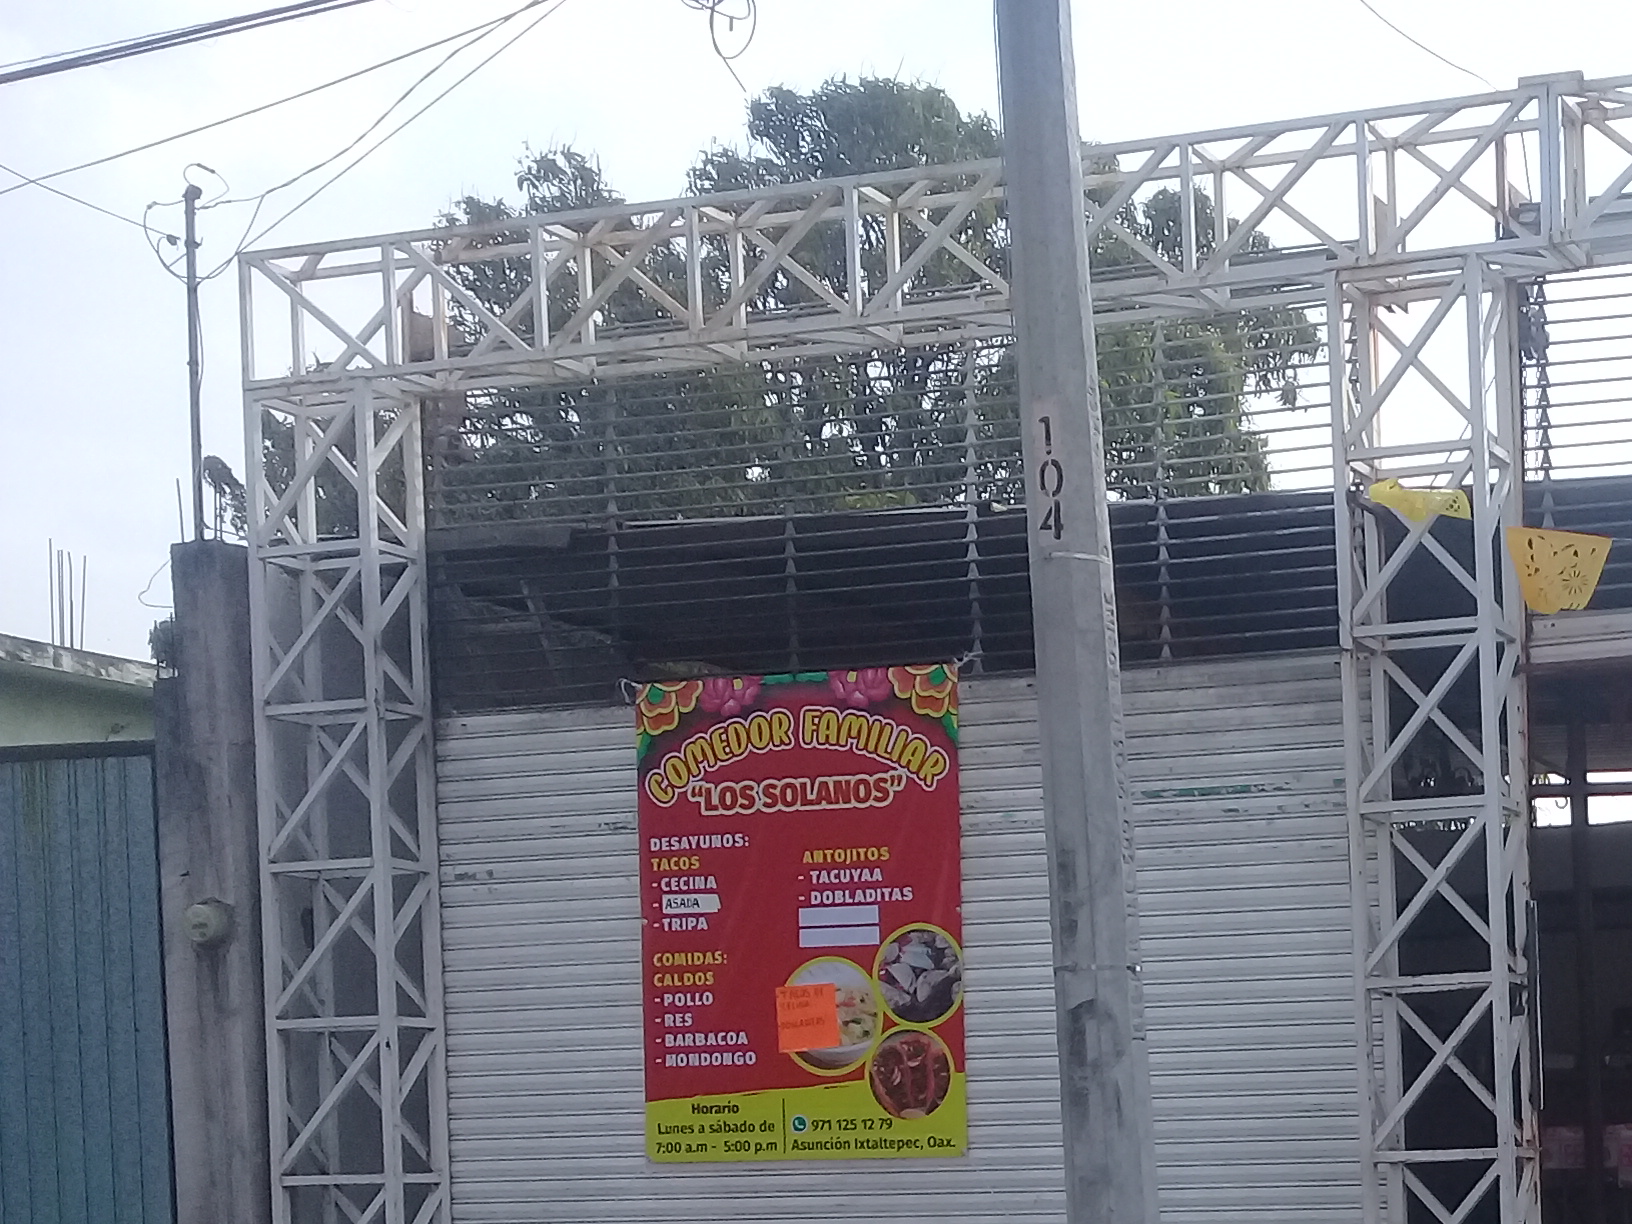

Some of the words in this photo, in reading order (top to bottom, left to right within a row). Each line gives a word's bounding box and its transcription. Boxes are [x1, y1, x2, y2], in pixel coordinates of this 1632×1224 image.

[1038, 415, 1064, 540] 104
[648, 710, 793, 804] COMEDOR
[802, 708, 948, 789] FAMILIAR
[650, 833, 749, 852] DESAYUNOS:
[651, 855, 700, 872] TACOS
[803, 846, 890, 865] ANTOJITOS
[660, 875, 717, 892] CECINA
[810, 867, 883, 884] TACUYAA
[665, 897, 700, 910] ASADA
[811, 887, 913, 905] DOBLADITAS
[662, 916, 708, 932] TRIPA
[653, 951, 727, 966] COMIDAS:
[653, 971, 715, 987] CALDOS
[663, 991, 714, 1007] POLLO
[664, 1012, 693, 1028] RES
[665, 1031, 748, 1048] BARBACOA
[665, 1051, 757, 1068] MONDONGO
[691, 1100, 740, 1115] Horario
[657, 1122, 695, 1136] Lunes
[698, 1123, 705, 1134] a
[709, 1119, 756, 1134] sábado
[759, 1119, 775, 1133] de
[811, 1118, 832, 1131] 971
[836, 1118, 857, 1131] 125
[861, 1118, 875, 1130] 12
[878, 1117, 893, 1130] 79
[656, 1141, 682, 1154] 7:00
[685, 1141, 708, 1153] a.m
[723, 1140, 751, 1153] 5:00
[754, 1141, 778, 1155] p.m
[791, 1136, 850, 1151] Asunción
[854, 1136, 924, 1152] Ixtaltepec,
[927, 1136, 956, 1149] Oax.
